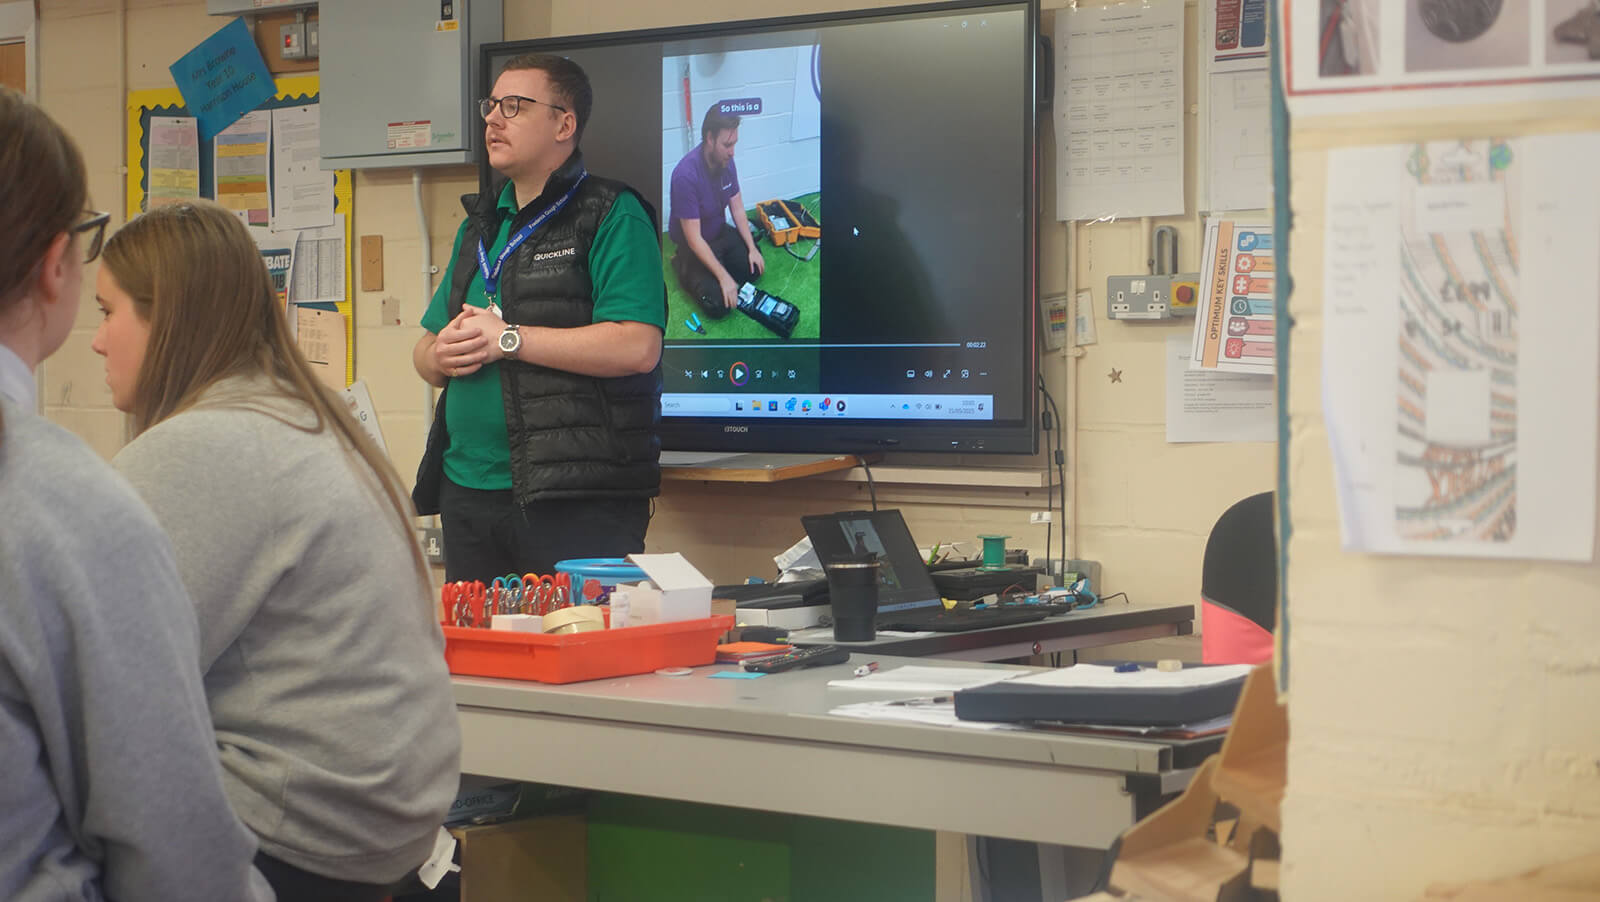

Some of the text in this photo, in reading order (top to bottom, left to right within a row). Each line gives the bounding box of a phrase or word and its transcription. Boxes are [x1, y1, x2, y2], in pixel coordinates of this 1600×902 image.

[206, 64, 234, 89] Year 10
[232, 72, 257, 93] House
[721, 104, 731, 113] So
[731, 103, 745, 112] this
[746, 102, 753, 111] is
[264, 254, 291, 270] BATE
[533, 247, 576, 261] QUICKLINE
[1210, 247, 1229, 340] OPTIMUM KEY SKILLS
[455, 793, 495, 809] O-OFFICE
